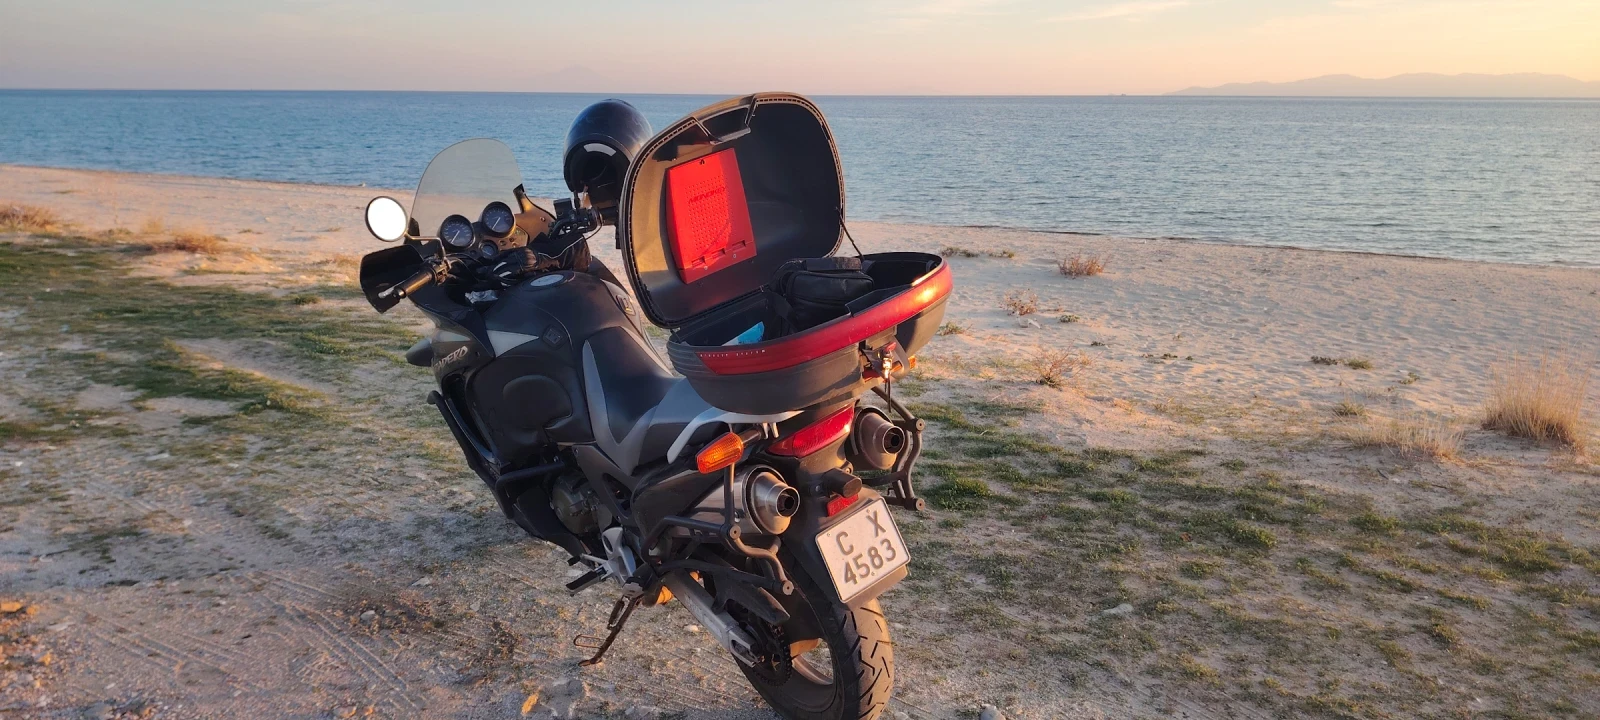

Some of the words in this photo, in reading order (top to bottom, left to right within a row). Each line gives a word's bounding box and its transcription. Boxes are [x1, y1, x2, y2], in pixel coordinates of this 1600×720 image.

[836, 531, 854, 556] C
[866, 510, 886, 537] X
[844, 538, 896, 585] 4583
